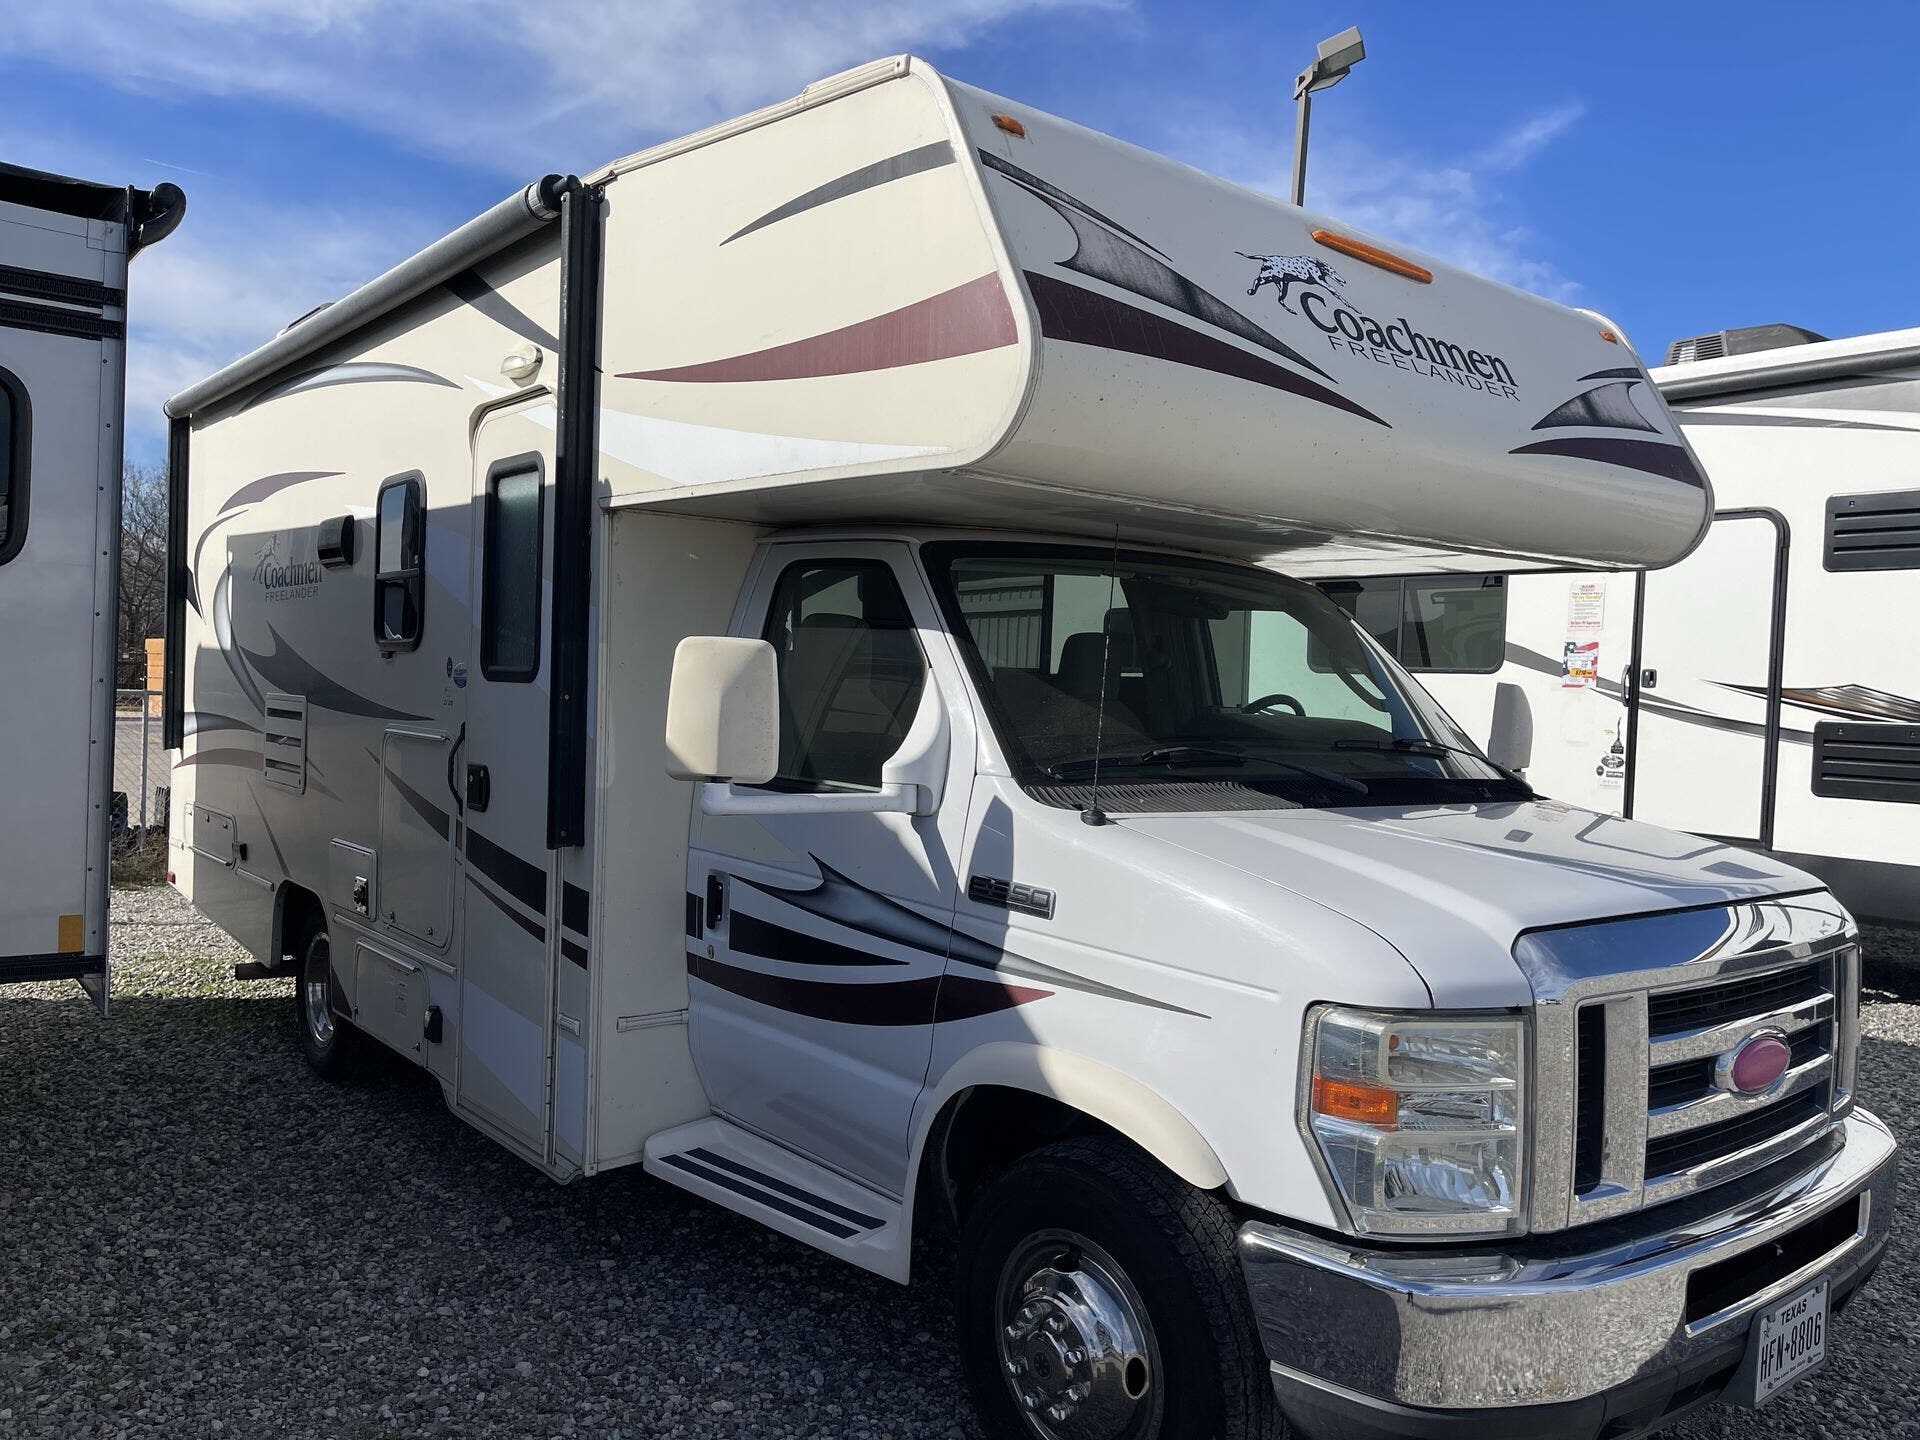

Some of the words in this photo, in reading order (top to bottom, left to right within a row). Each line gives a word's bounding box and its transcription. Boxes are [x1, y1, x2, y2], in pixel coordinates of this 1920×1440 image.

[1300, 291, 1520, 388] Coachmen
[1327, 335, 1521, 402] FREELANDER
[264, 556, 323, 590] Coachmen
[265, 586, 319, 602] FREELANDER
[1781, 1298, 1807, 1326] TEXAS
